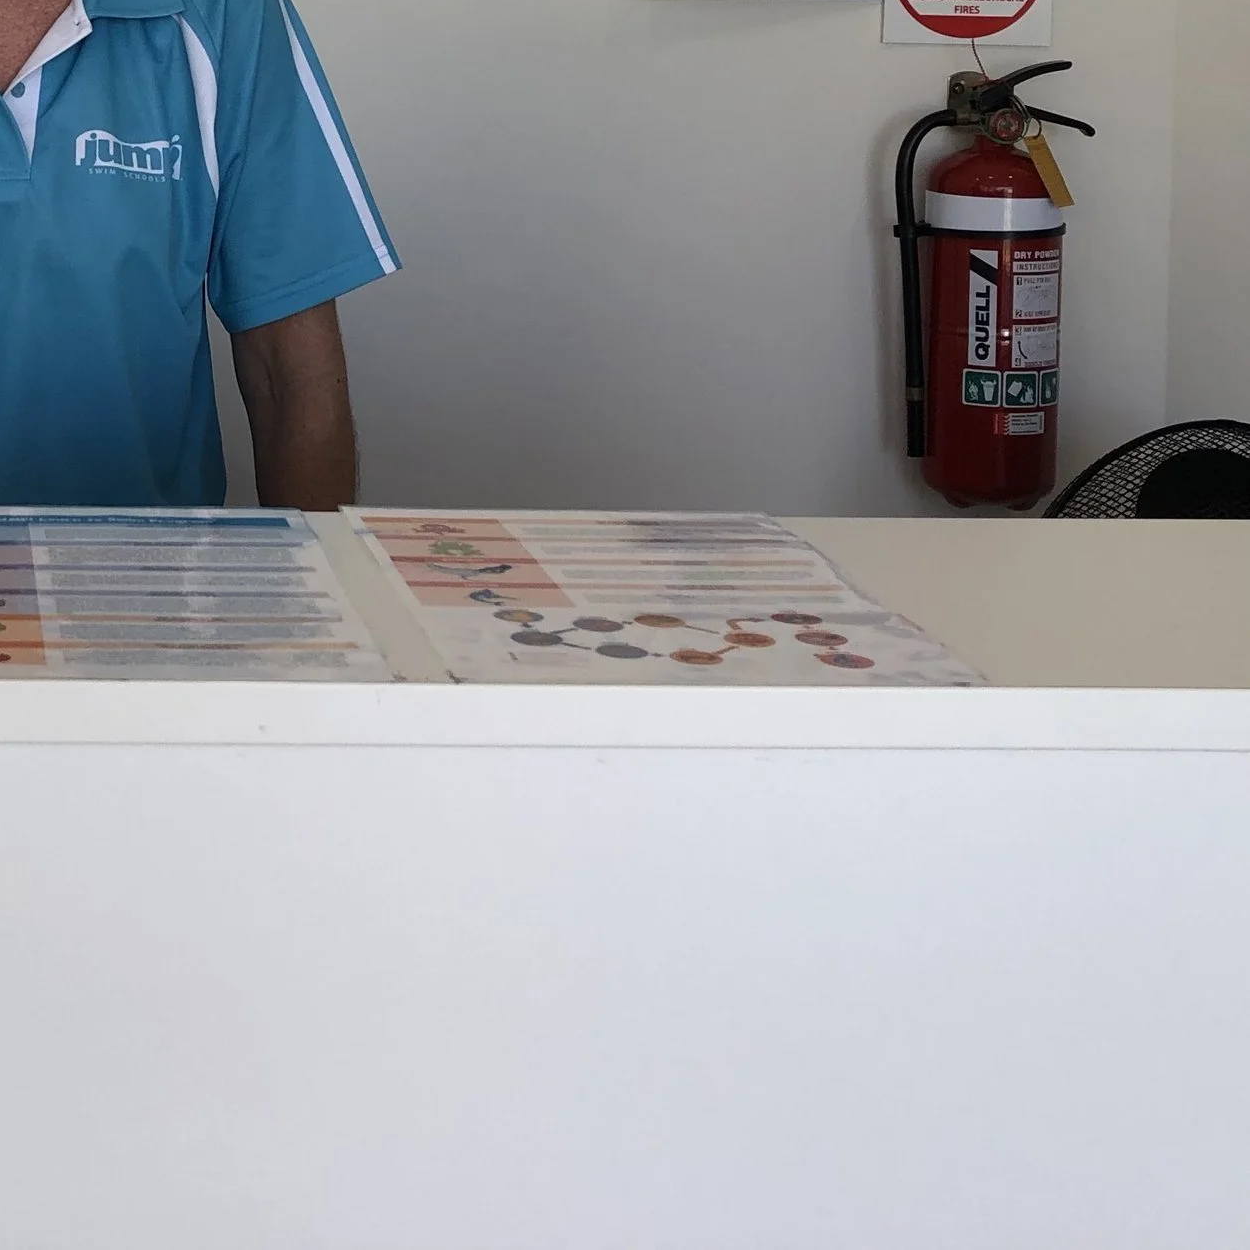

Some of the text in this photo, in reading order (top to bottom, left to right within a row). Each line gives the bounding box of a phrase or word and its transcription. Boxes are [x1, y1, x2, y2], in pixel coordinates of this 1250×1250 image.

[954, 5, 980, 14] FIRES
[123, 172, 166, 182] SCHOOLS
[1014, 251, 1032, 259] DRY
[974, 285, 991, 361] QUELL
